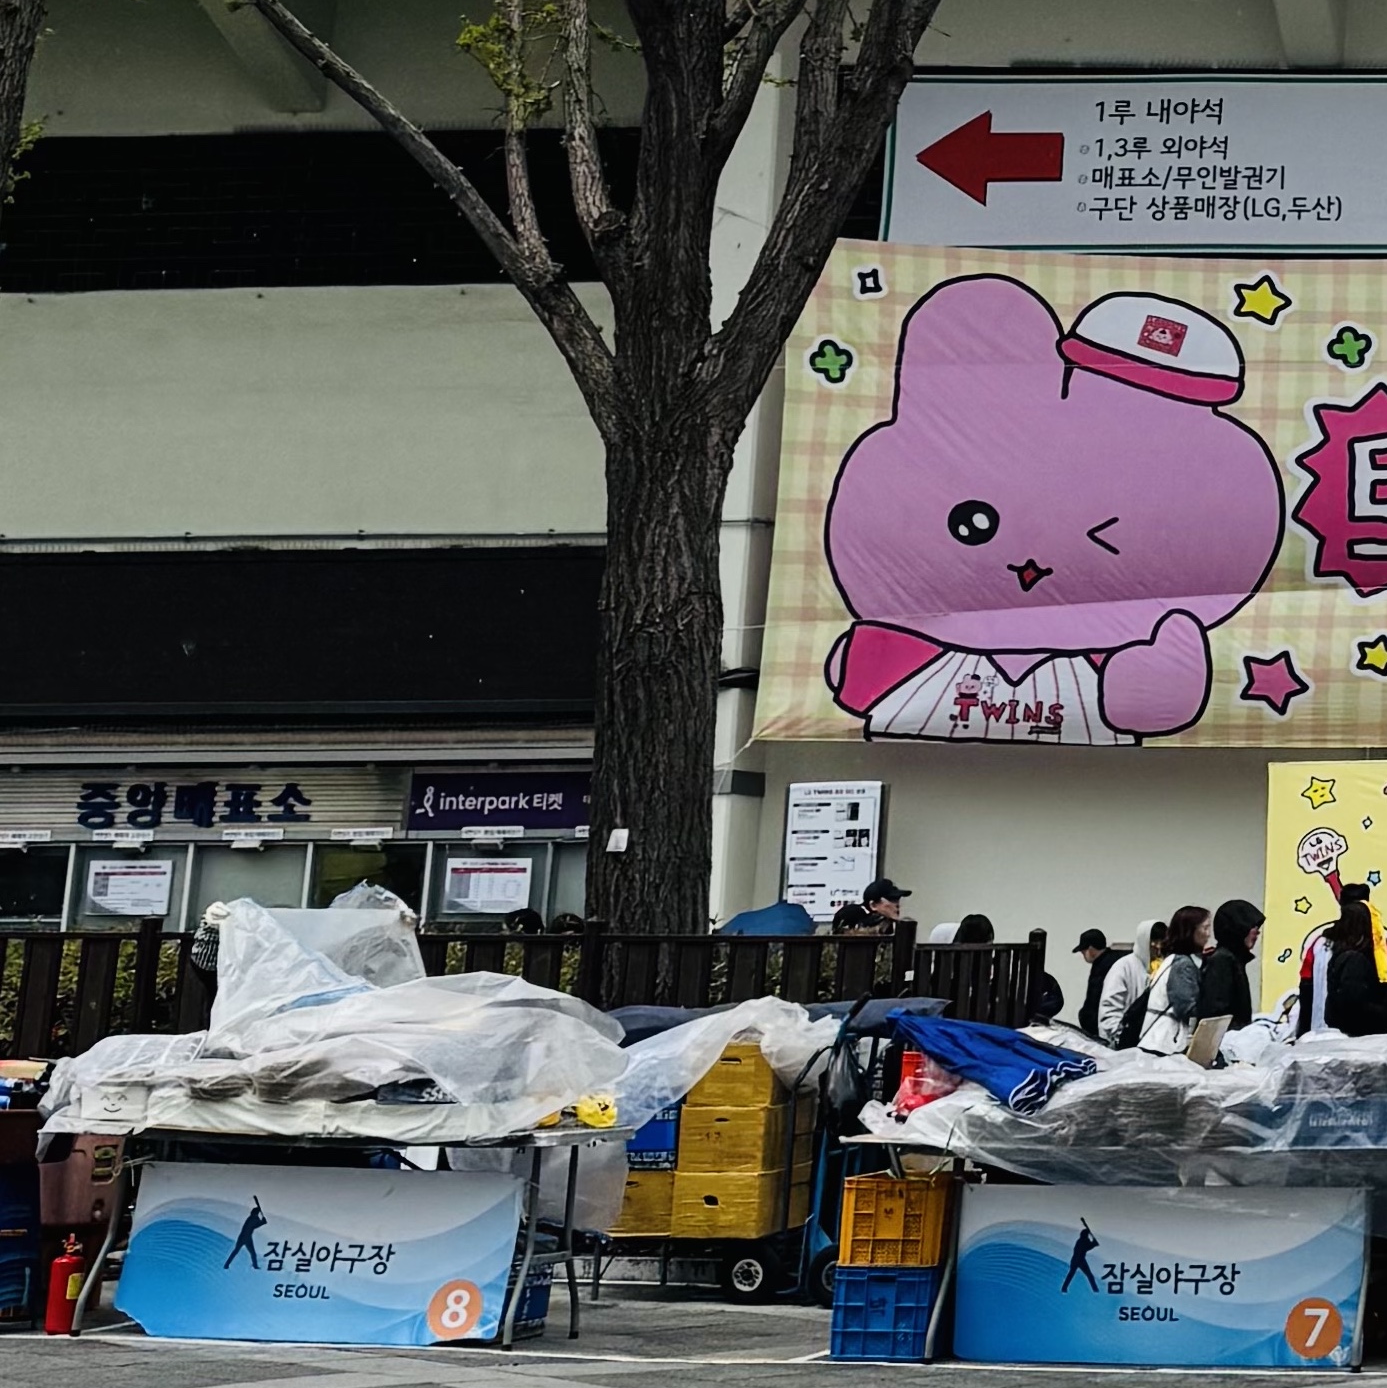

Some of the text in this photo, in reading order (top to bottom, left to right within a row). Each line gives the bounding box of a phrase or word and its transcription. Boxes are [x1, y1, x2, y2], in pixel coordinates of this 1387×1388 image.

[1094, 97, 1224, 125] 1루 내야석
[1094, 134, 1229, 161] 1,3루 외야석
[1091, 165, 1286, 191] 매표소/무인발권기
[1088, 195, 1343, 222] 구단 상품매장(LG,두산)
[953, 696, 1065, 725] TWINS
[76, 781, 312, 829] 중앙매표소
[438, 792, 530, 815] interpark
[532, 792, 564, 811] 티켓
[1301, 838, 1343, 866] TWINS
[263, 1240, 396, 1275] 잠실야구장
[273, 1283, 331, 1300] SEOUL
[1101, 1262, 1241, 1296] 잠실야구장
[440, 1289, 471, 1329] 8
[1118, 1305, 1180, 1322] SEOUL
[1304, 1308, 1330, 1348] 7
